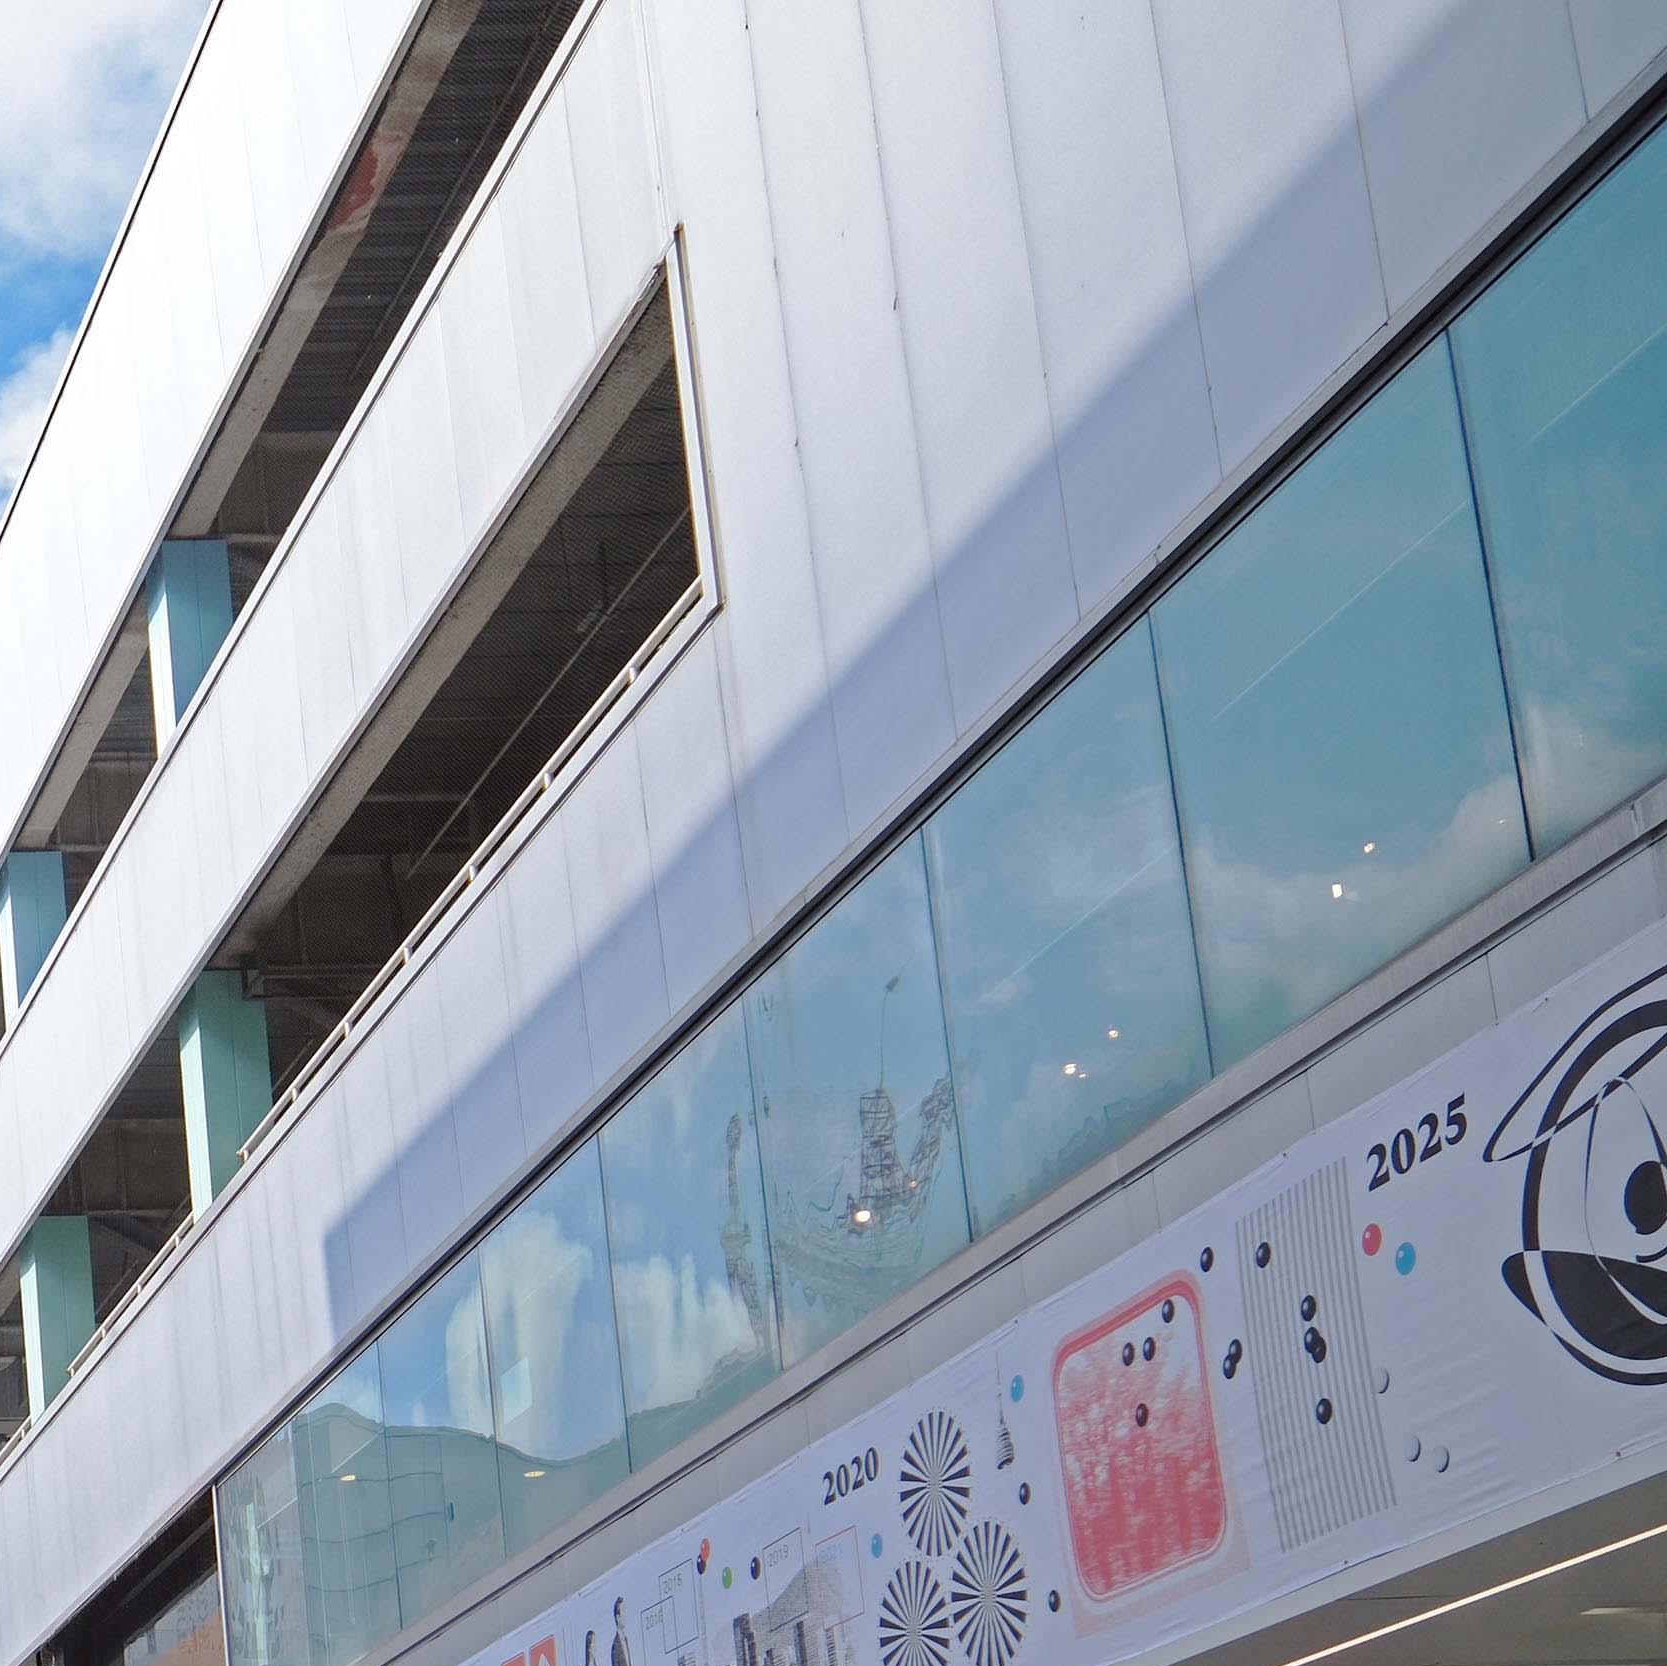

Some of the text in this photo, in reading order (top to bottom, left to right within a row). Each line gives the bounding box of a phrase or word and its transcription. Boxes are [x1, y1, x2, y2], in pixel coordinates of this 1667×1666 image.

[1366, 1093, 1468, 1191] 2025
[822, 1446, 880, 1507] 2020
[768, 1545, 789, 1567] 2019
